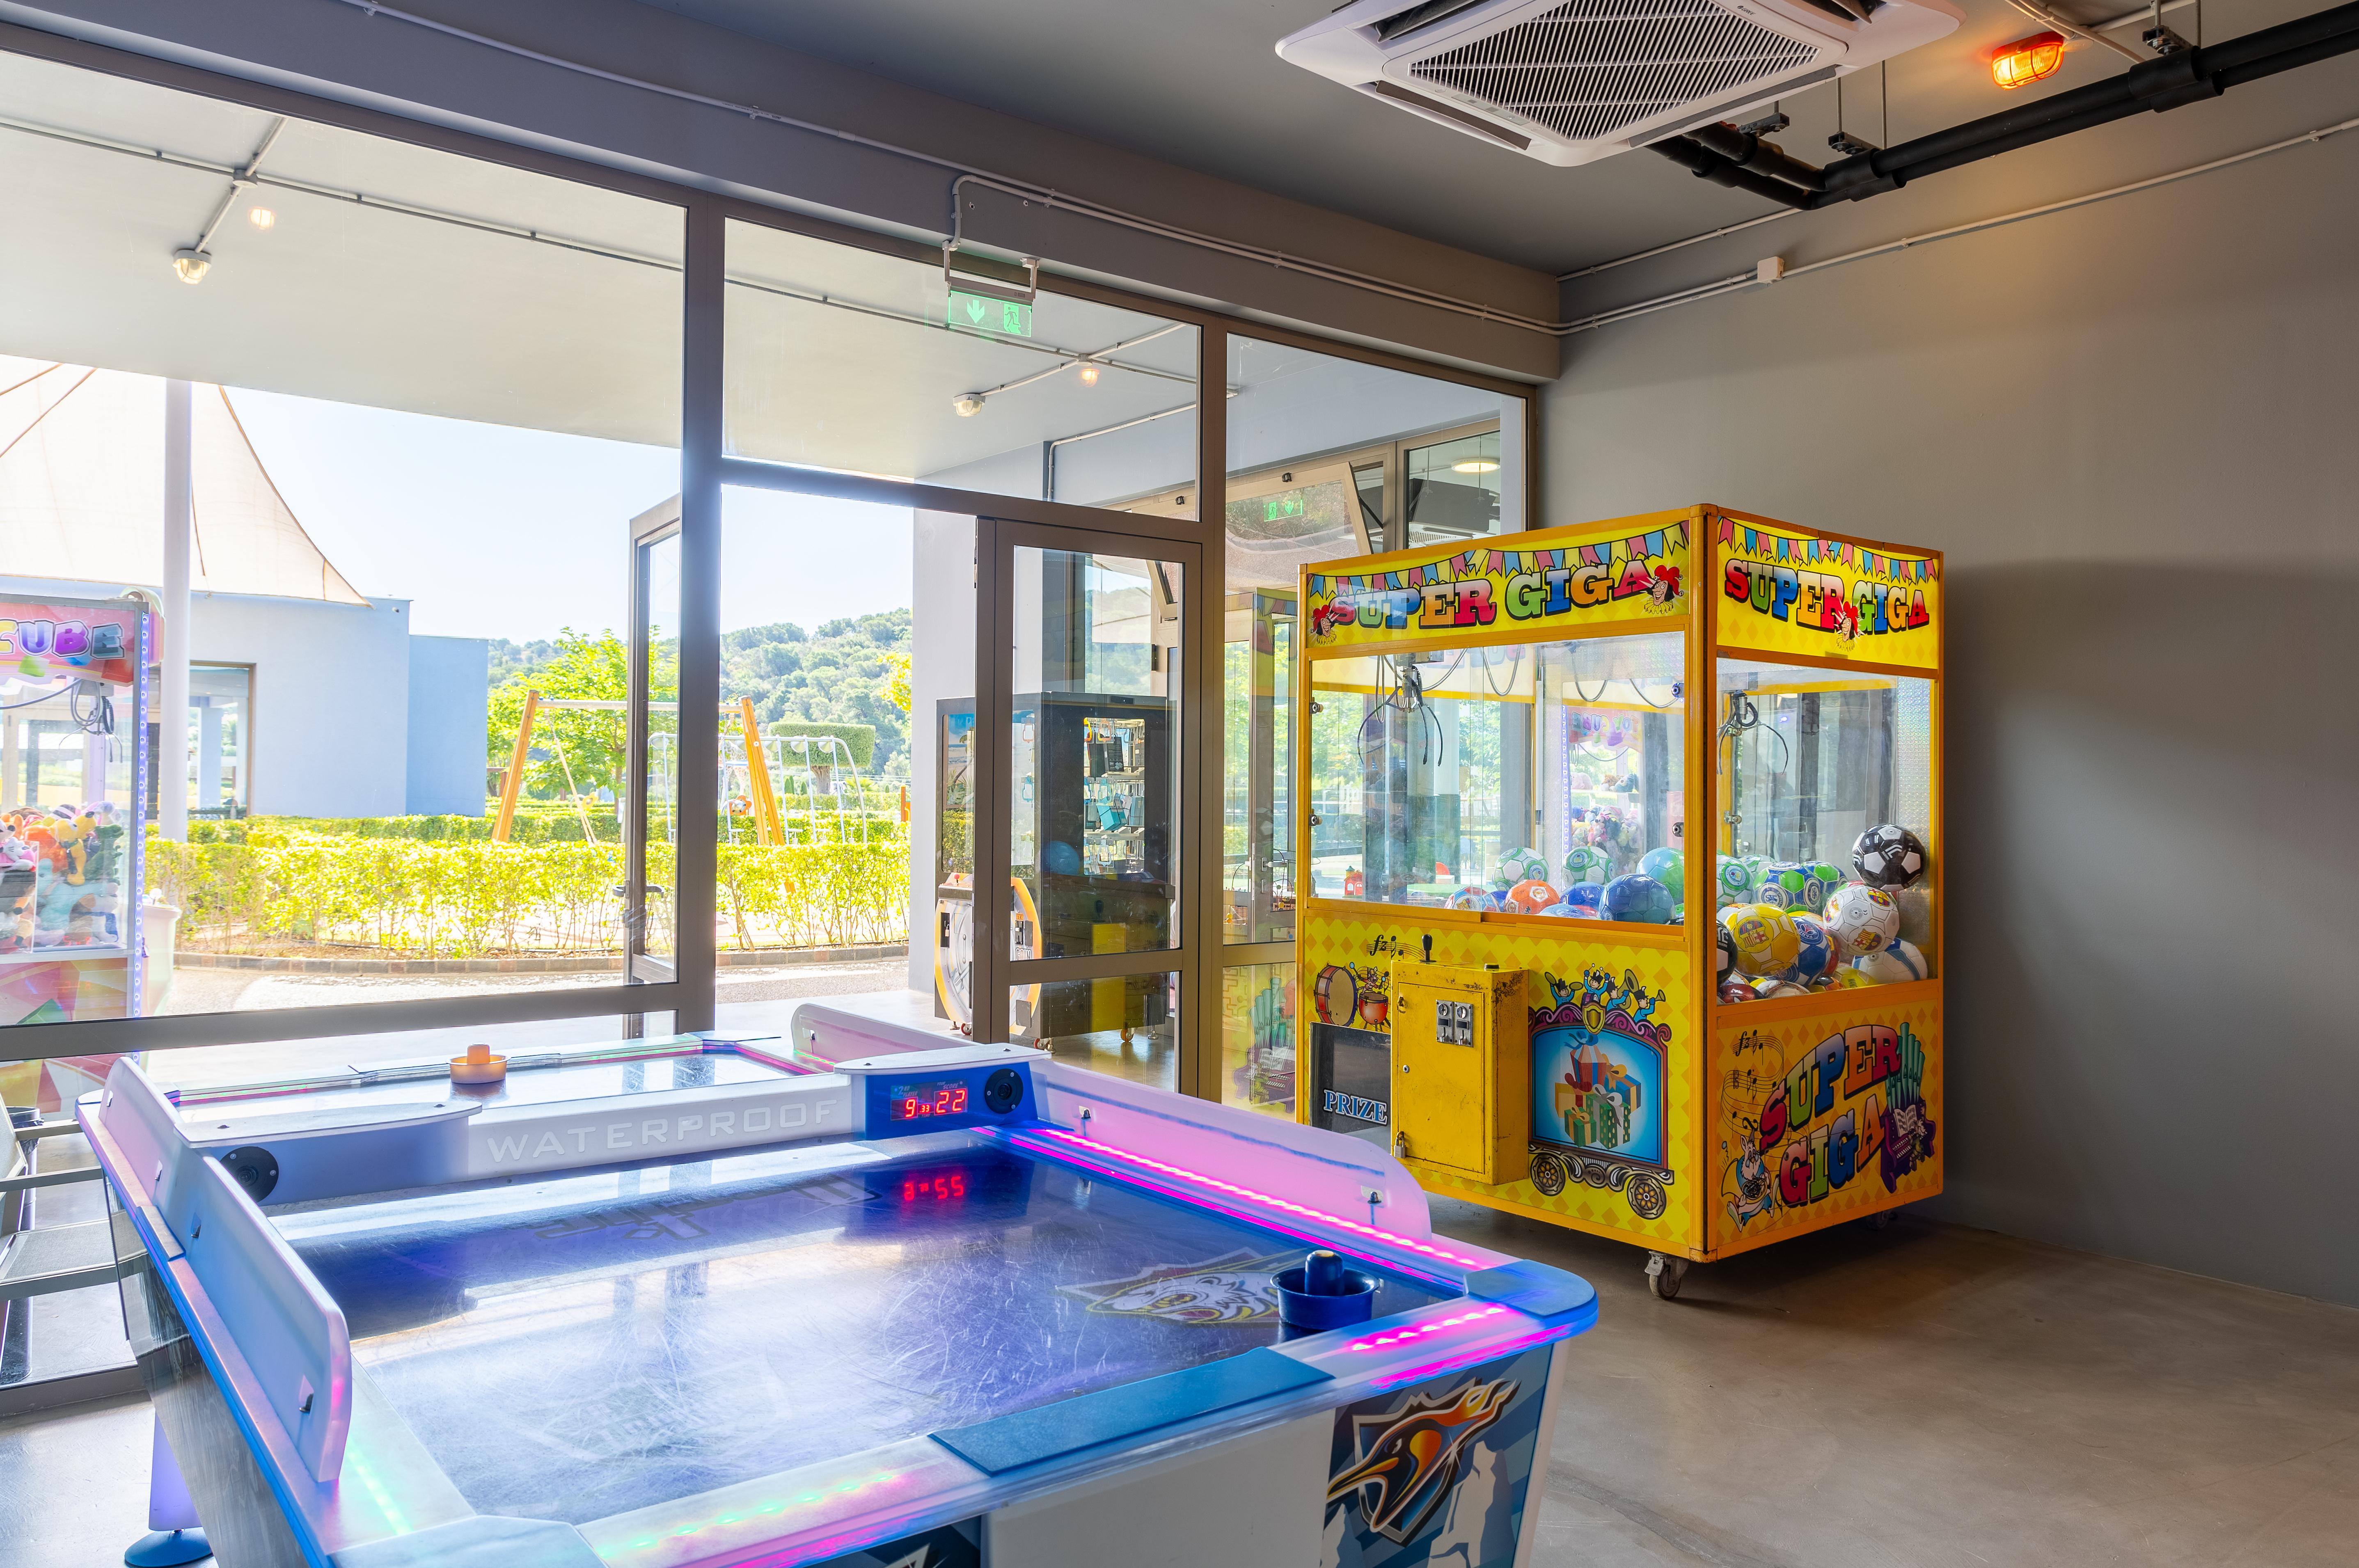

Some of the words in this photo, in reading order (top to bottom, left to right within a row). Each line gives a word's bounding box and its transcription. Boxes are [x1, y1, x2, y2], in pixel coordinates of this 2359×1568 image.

[1330, 579, 1497, 629] SUPER
[1505, 560, 1652, 620] GIGA
[1725, 558, 1845, 633] SUPER
[1853, 580, 1929, 635] GIGA
[1016, 948, 1031, 960] COIN
[905, 1099, 916, 1117] 9
[936, 1090, 965, 1114] 22
[1324, 1090, 1387, 1125] PRIZE
[1759, 1025, 1901, 1151] SUPER
[487, 1099, 837, 1163] WATERPROOF
[1779, 1094, 1886, 1209] GIGA
